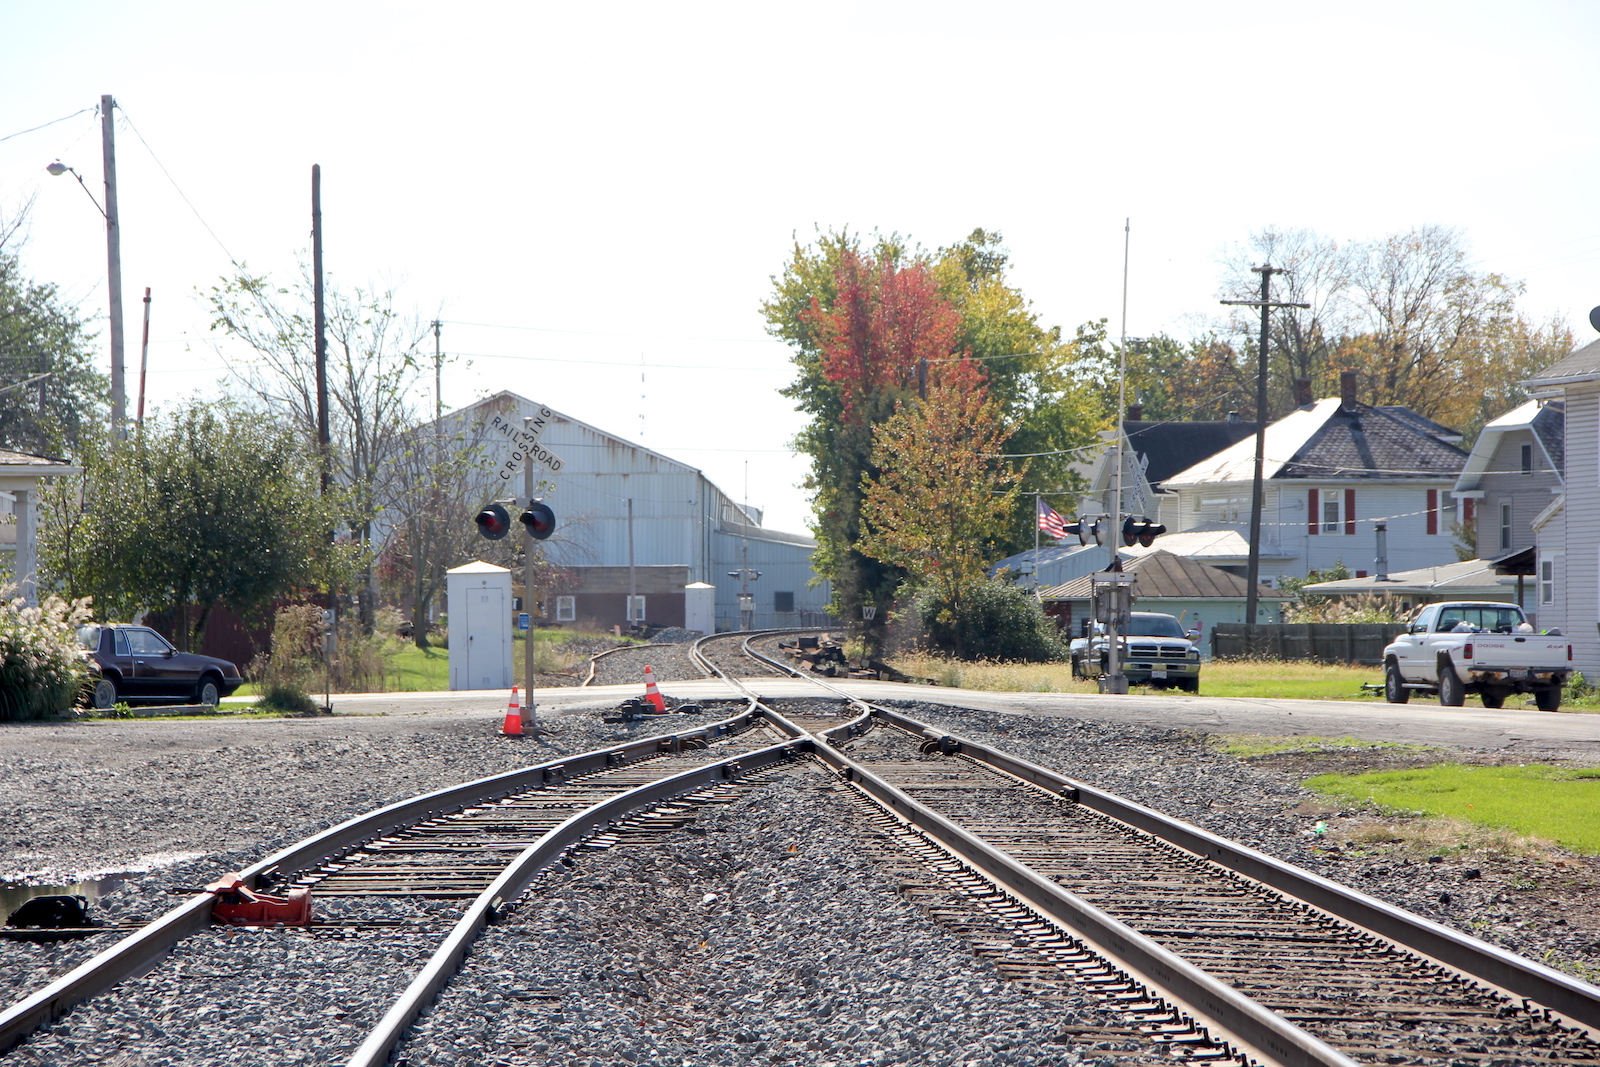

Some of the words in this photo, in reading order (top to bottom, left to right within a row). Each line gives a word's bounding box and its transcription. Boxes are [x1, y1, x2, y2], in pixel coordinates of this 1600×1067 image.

[491, 416, 561, 471] RAILROAD
[499, 407, 551, 480] CROSSING
[864, 607, 875, 619] W
